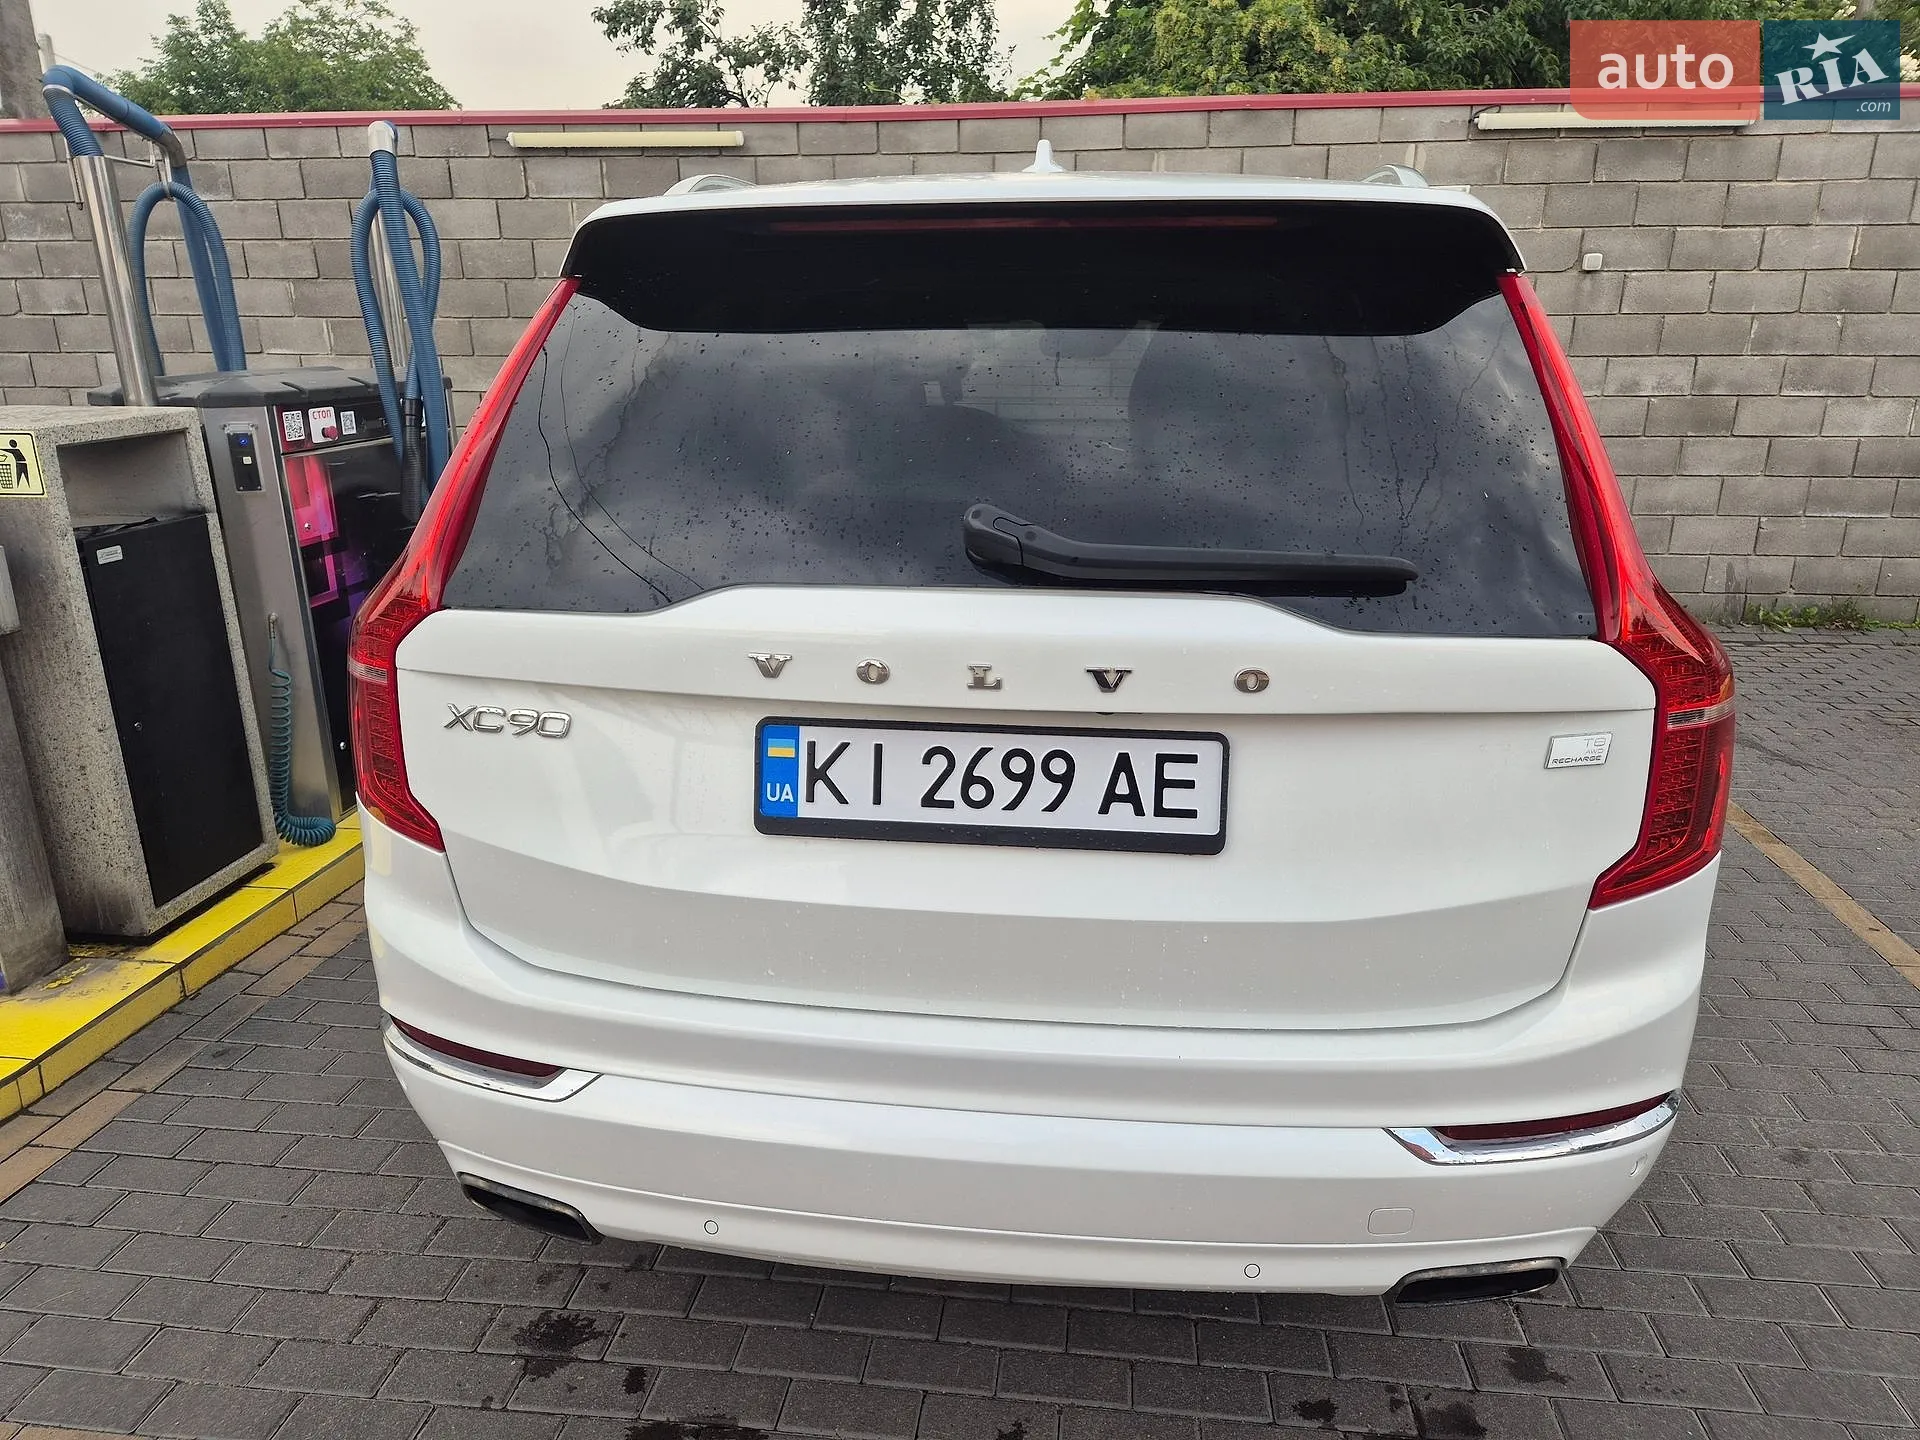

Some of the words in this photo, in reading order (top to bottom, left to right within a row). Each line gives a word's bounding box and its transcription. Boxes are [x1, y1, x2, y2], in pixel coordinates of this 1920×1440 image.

[748, 652, 1271, 695] VOLVO
[444, 702, 572, 739] XC90
[1551, 754, 1602, 765] RECHARGE
[766, 783, 795, 804] UA
[804, 739, 884, 806] KI
[919, 745, 1077, 813] 2699
[1097, 751, 1199, 820] AE
